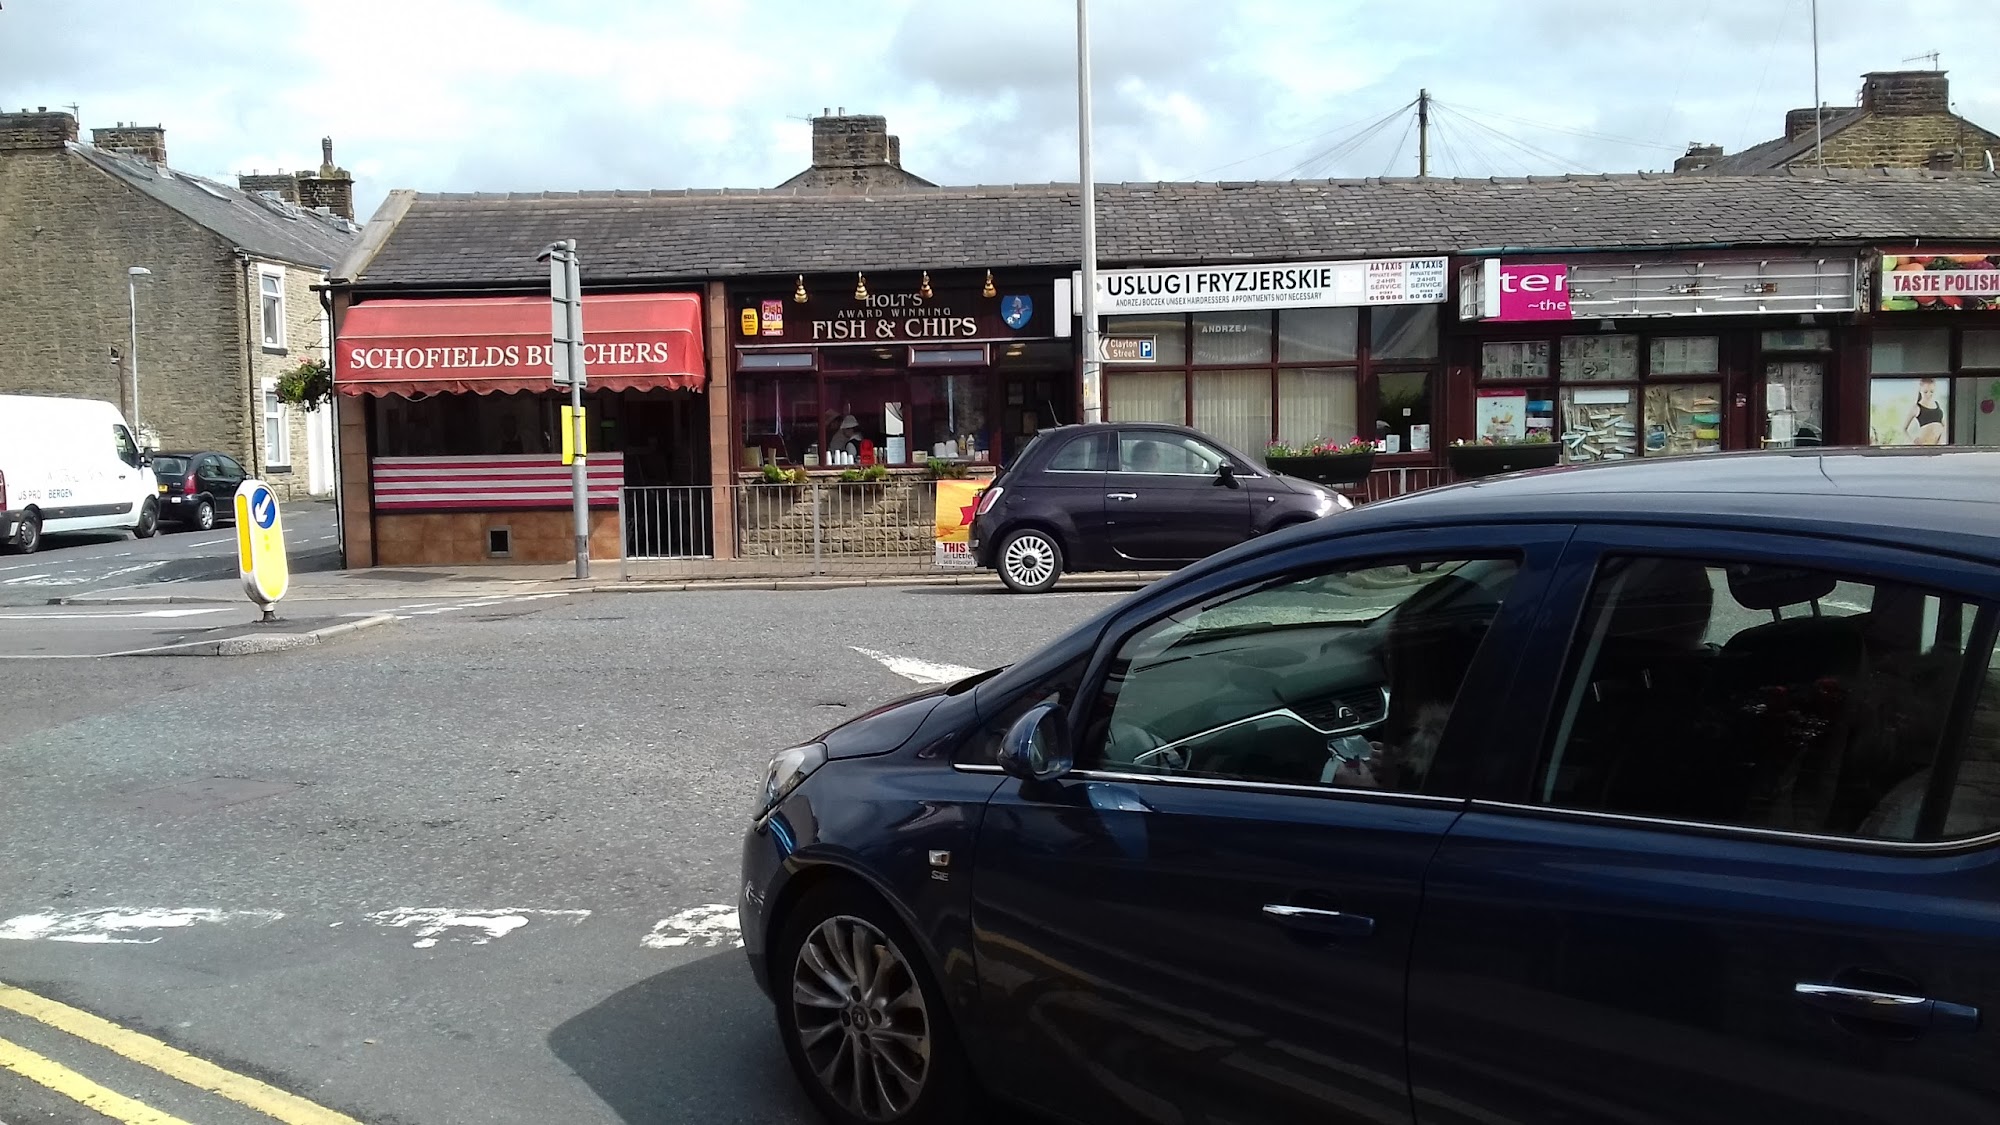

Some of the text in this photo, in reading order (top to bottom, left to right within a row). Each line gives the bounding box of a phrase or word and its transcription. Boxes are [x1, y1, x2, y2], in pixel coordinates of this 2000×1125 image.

[1422, 261, 1443, 269] TAXIS
[1197, 268, 1331, 293] FRYZJERSKIE
[1893, 273, 2000, 292] TASTE POLISH
[865, 293, 923, 308] HOLT'S
[1116, 299, 1142, 307] ANDRZEJ
[1142, 298, 1166, 306] BOCZEK
[1166, 297, 1186, 305] UNISEX
[1187, 296, 1230, 305] HAIRDRESSERS
[1275, 293, 1288, 302] NOT
[1288, 292, 1322, 301] NECESSARY
[837, 307, 951, 319] AWARD WINNING
[812, 317, 978, 340] FISH & CHIPS
[1201, 325, 1247, 334] ANDRZEJ
[1110, 339, 1138, 350] Clayton
[1142, 341, 1151, 356] P
[350, 345, 520, 369] SCHOFIELDS
[1113, 348, 1136, 358] Street
[48, 488, 73, 499] BERGEN
[942, 542, 966, 553] THIS
[931, 870, 949, 881] SE
